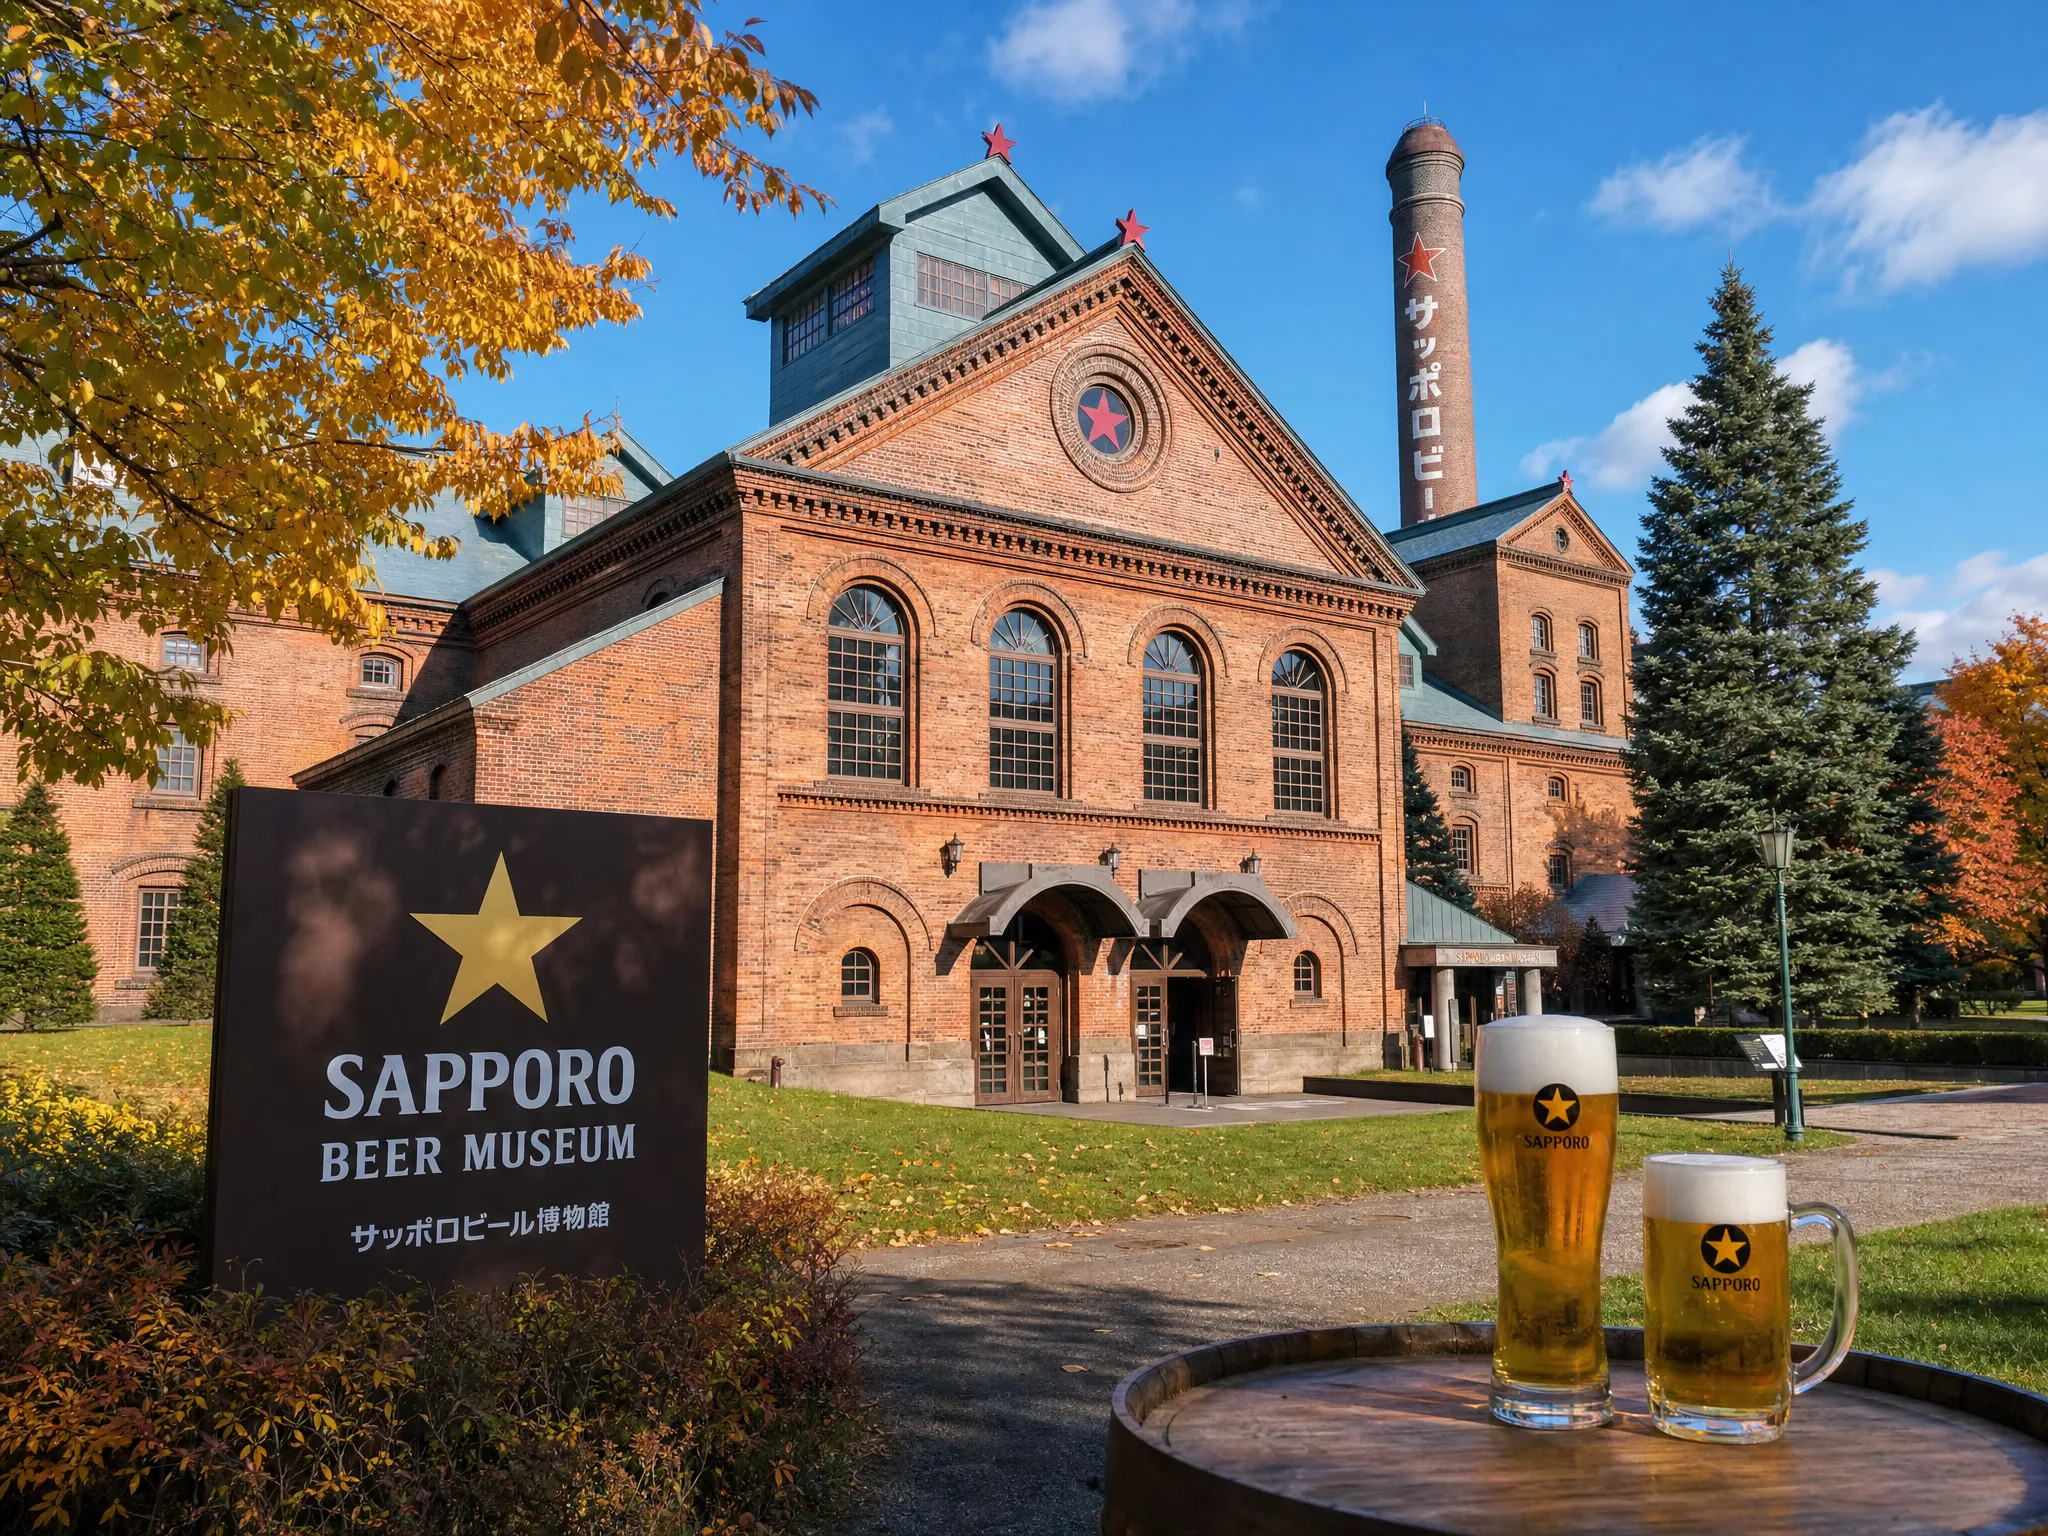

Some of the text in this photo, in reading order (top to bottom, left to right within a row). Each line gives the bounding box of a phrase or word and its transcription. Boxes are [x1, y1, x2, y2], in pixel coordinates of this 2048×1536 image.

[1405, 295, 1444, 523] サッポロビー
[323, 1046, 636, 1120] SAPPORO
[320, 1123, 636, 1183] BEER MUSEUM
[1523, 1134, 1590, 1150] SAPPORO
[350, 1201, 610, 1253] サッポロビール博物館
[1691, 1275, 1761, 1292] SAPPORO
